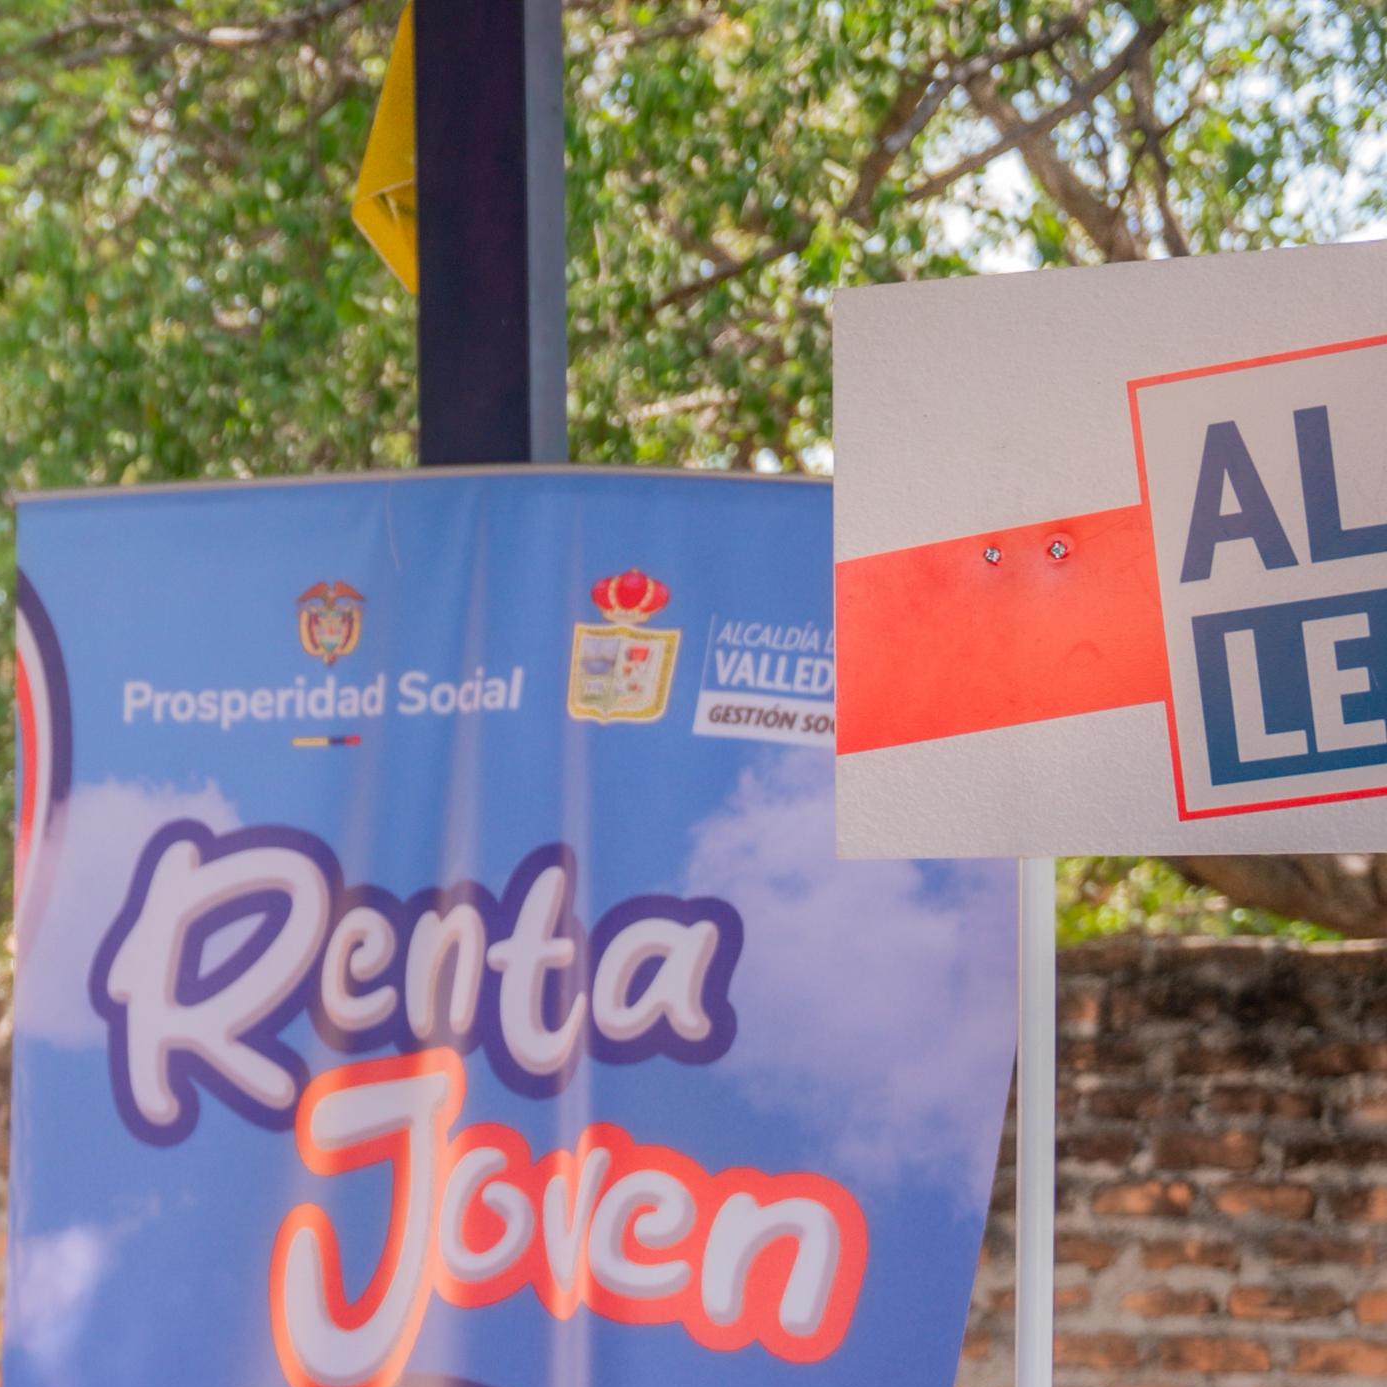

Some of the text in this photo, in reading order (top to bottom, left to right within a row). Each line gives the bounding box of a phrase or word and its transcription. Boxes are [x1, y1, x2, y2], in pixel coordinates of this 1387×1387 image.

[1179, 405, 1387, 584] AL
[715, 621, 820, 653] ALCALDÍA
[122, 666, 525, 731] Prosperidad Social
[714, 649, 835, 695] VALLED
[1224, 613, 1387, 764] LE
[708, 703, 798, 731] GESTIÓN
[100, 830, 729, 1133] Renta
